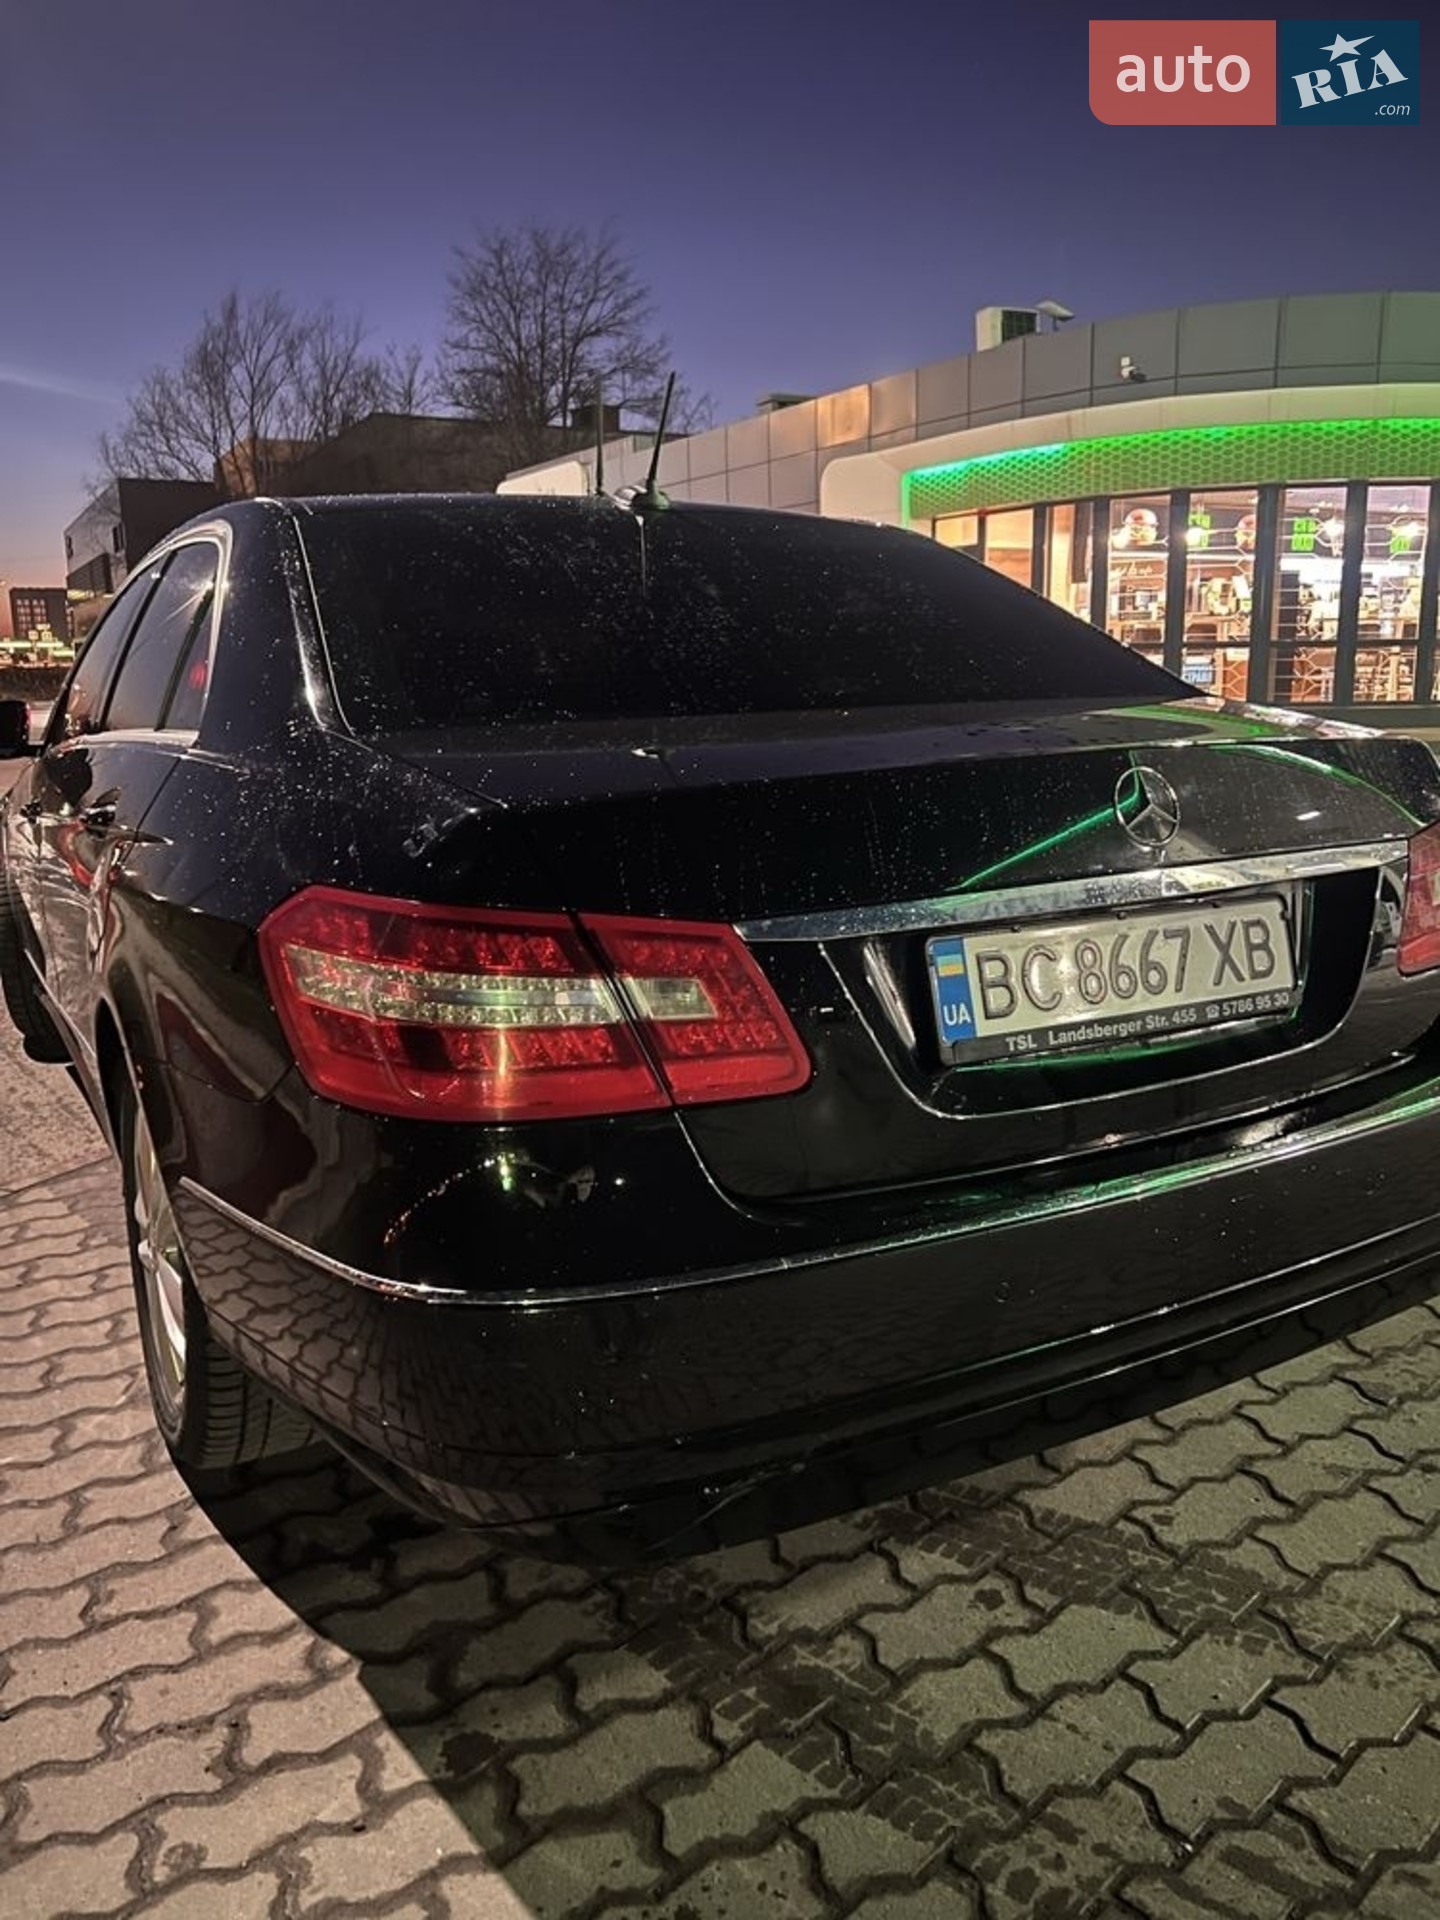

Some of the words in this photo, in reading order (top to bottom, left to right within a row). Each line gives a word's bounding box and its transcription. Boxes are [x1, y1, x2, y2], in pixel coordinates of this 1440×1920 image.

[975, 945, 1064, 1020] BC
[1074, 929, 1191, 1004] 8667
[1205, 918, 1276, 986] XB
[944, 1004, 972, 1026] UA
[1005, 1033, 1038, 1052] TSL
[1048, 1020, 1143, 1046] Landsberger
[1145, 1014, 1169, 1030] Str.
[1172, 1007, 1198, 1025] 455
